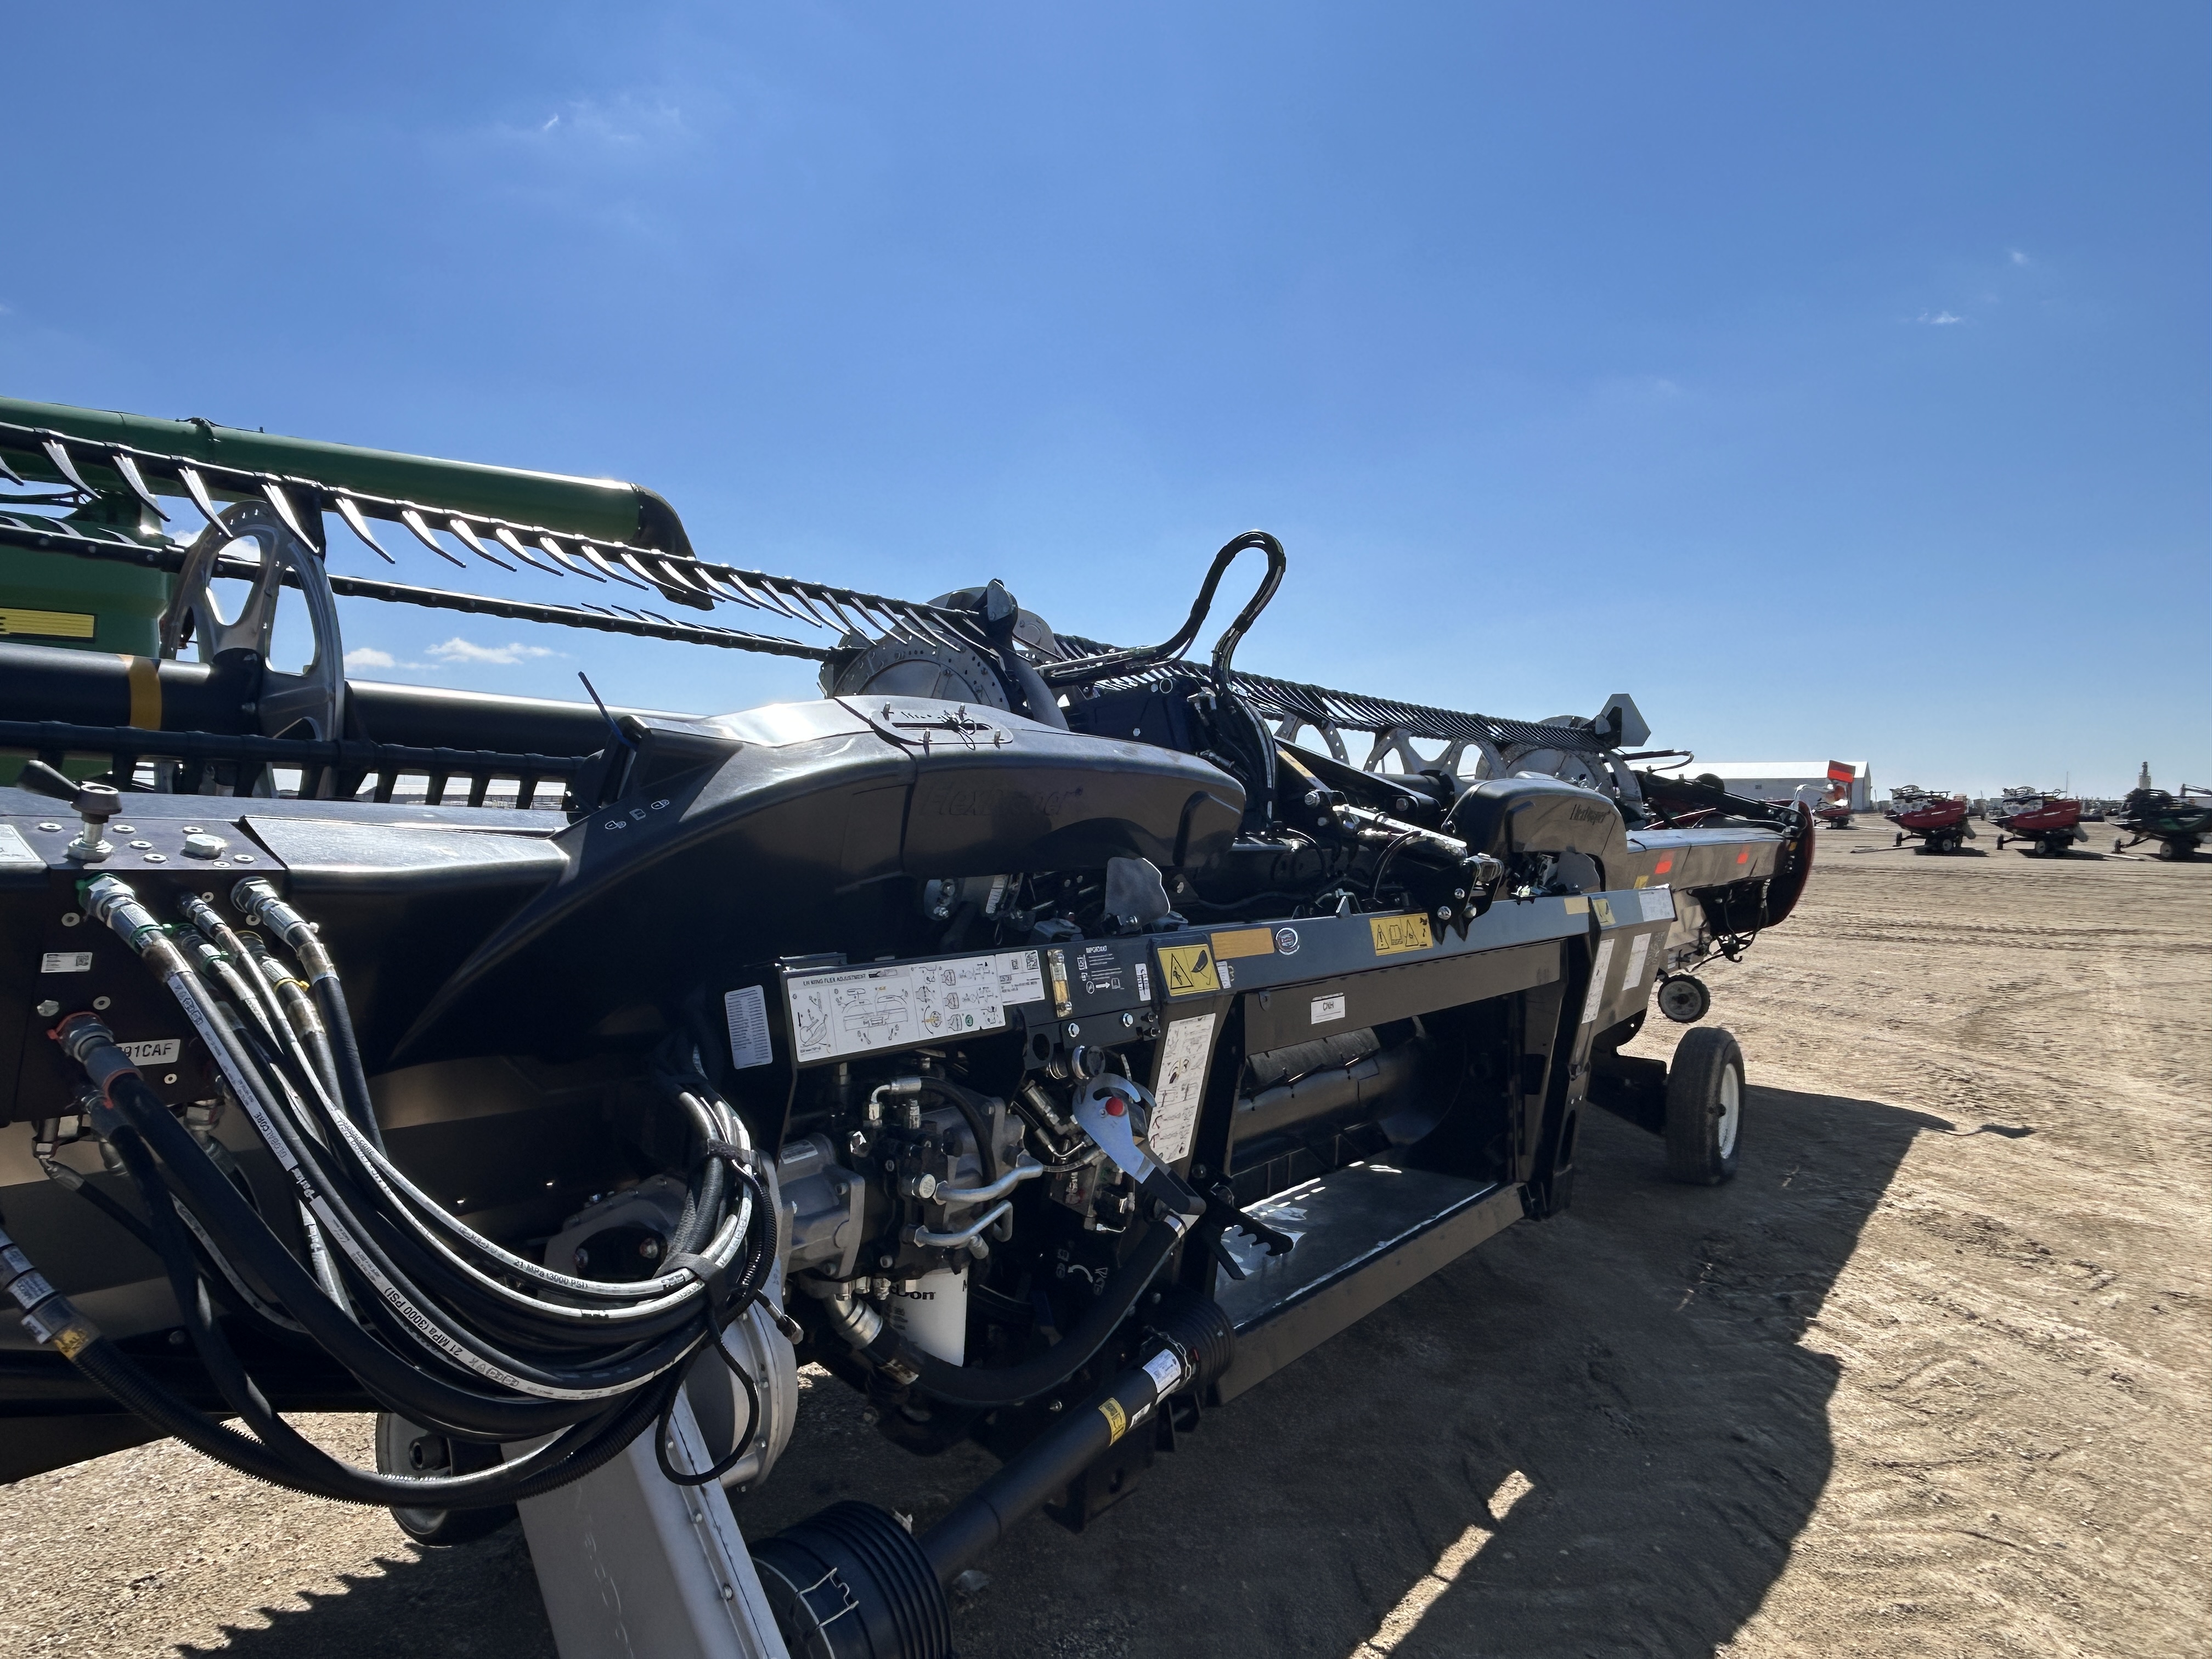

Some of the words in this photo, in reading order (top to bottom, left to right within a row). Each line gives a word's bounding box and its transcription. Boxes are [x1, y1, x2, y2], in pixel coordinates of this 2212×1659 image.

[121, 1043, 173, 1058] 91CAF
[384, 1287, 407, 1308] PSI)
[403, 1306, 430, 1330] (3000
[428, 1327, 450, 1347] MPa
[449, 1345, 463, 1356] 21
